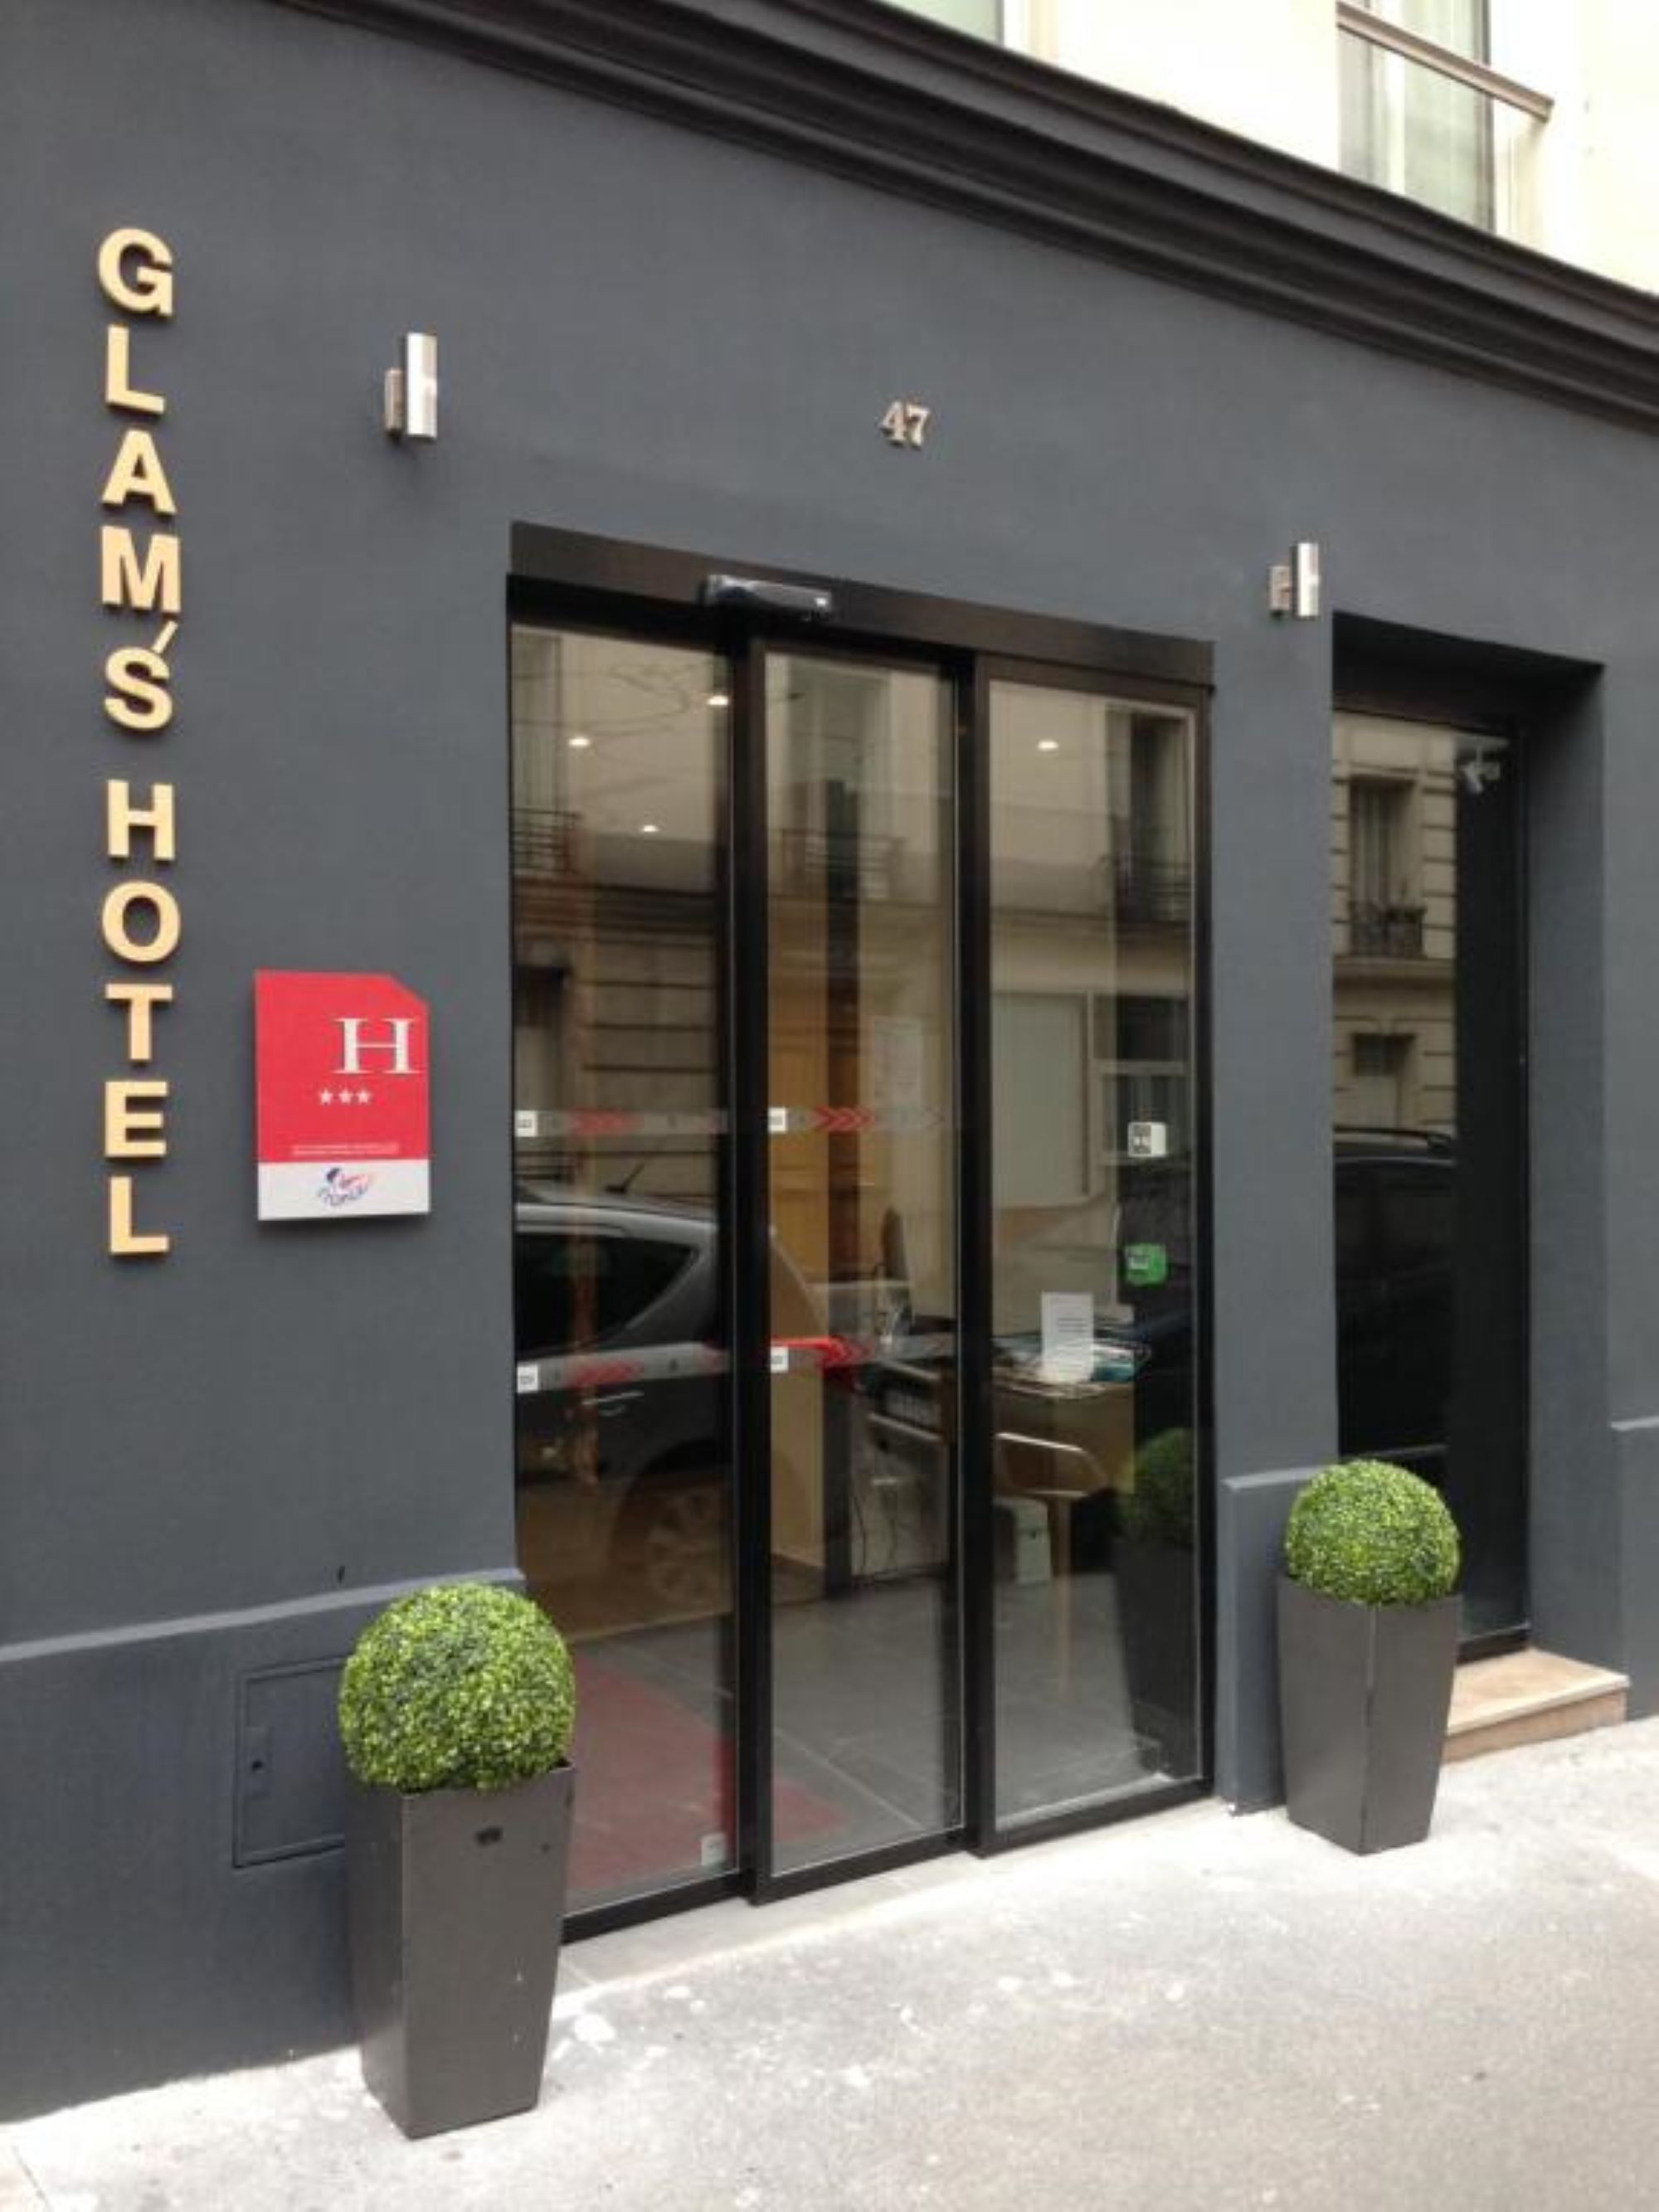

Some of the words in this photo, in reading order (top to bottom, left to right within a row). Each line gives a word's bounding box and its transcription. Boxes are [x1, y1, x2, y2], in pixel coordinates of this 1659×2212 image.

[881, 400, 930, 446] 47
[101, 779, 182, 1255] HOTEL
[333, 1017, 422, 1075] H
